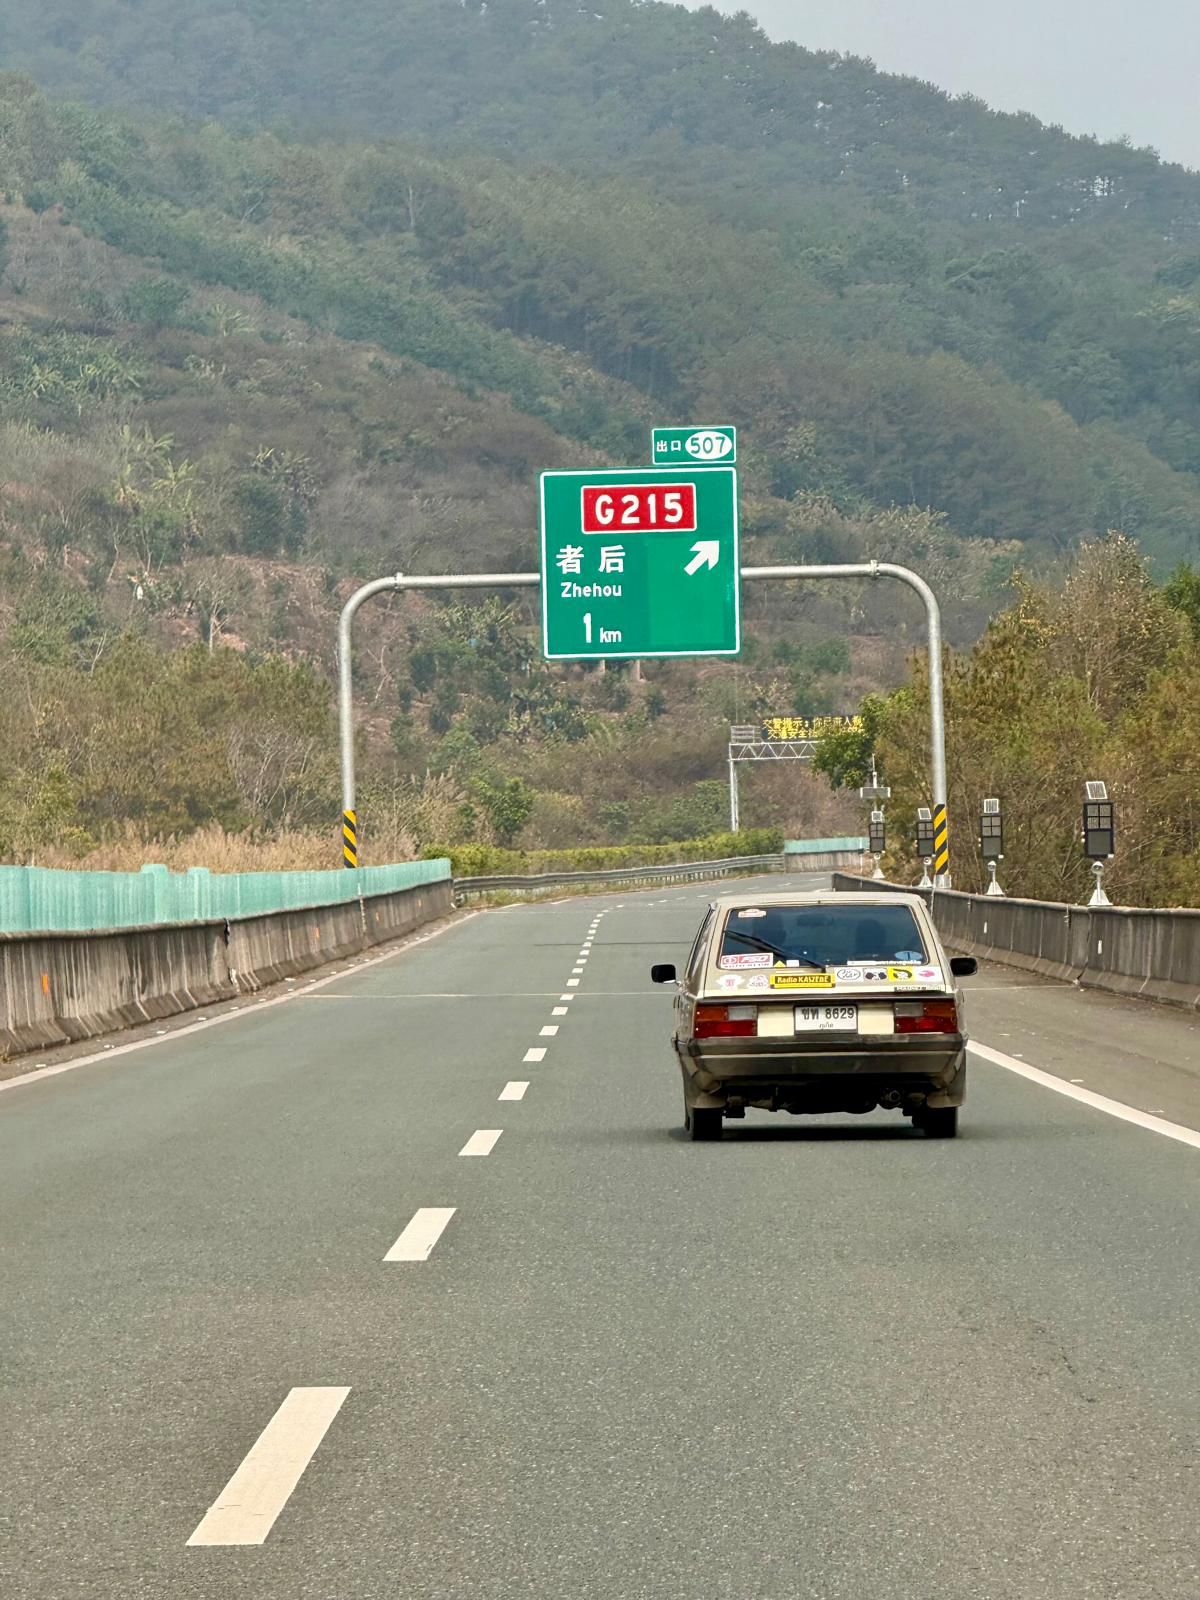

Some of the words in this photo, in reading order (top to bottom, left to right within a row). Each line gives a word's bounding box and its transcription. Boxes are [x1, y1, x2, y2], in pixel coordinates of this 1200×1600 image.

[656, 439, 681, 453] 出口
[690, 436, 726, 454] 507
[595, 492, 683, 525] G215
[555, 544, 626, 574] 者后
[560, 581, 622, 598] Zhehou
[583, 612, 592, 644] 1
[599, 627, 622, 643] km
[777, 976, 798, 984] Radio
[825, 1007, 855, 1020] 8629
